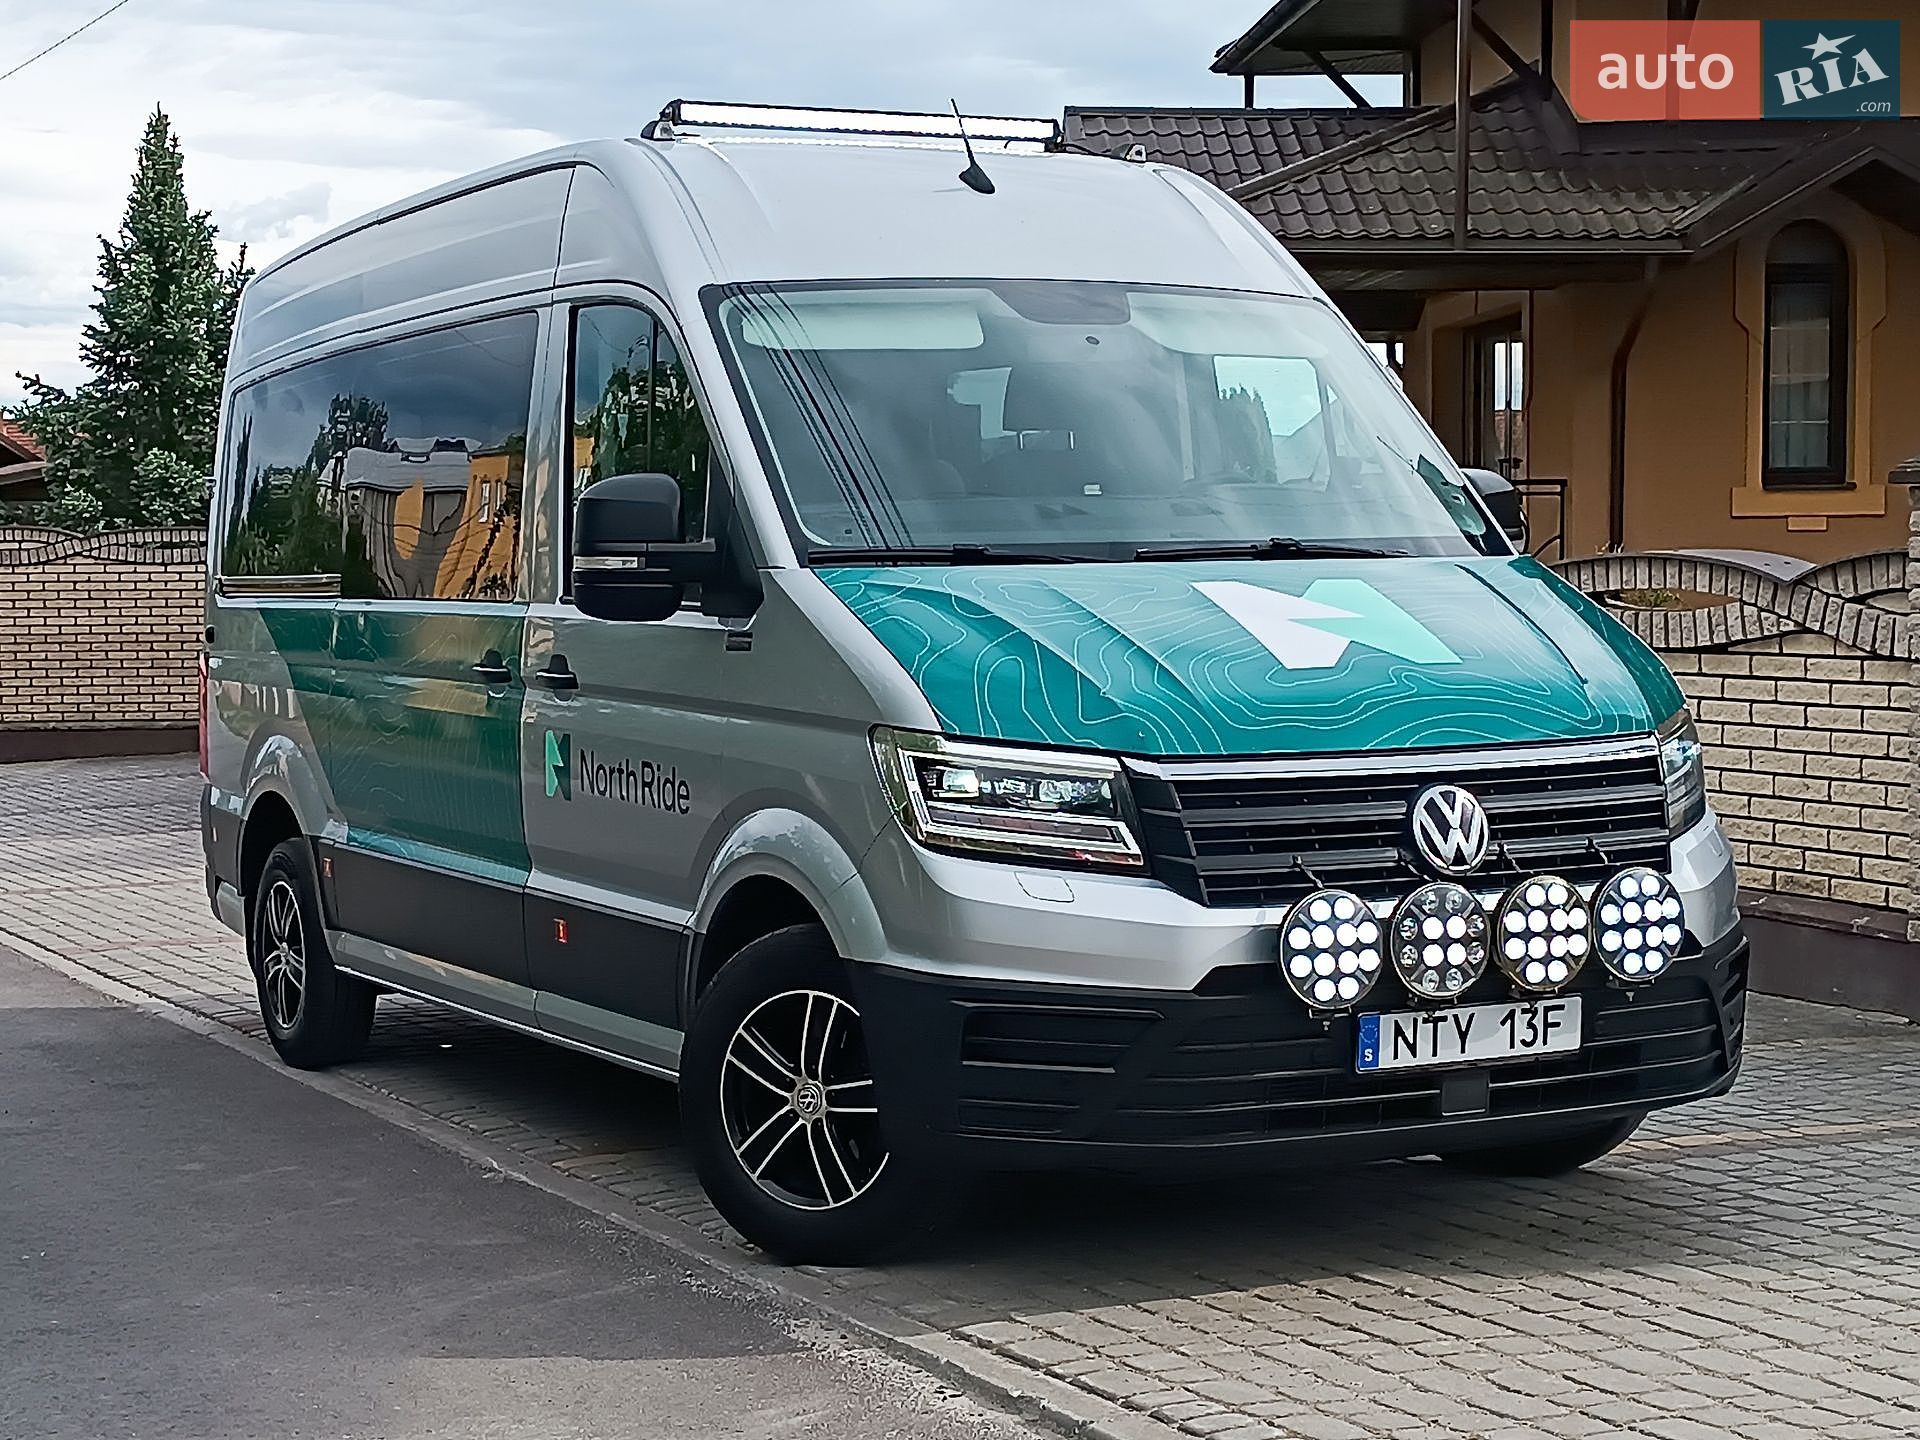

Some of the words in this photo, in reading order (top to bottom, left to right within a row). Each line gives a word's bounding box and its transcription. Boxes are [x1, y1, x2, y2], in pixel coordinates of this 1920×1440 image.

[1393, 1012, 1476, 1061] NTY
[1499, 1004, 1566, 1050] 13F
[1364, 1048, 1374, 1062] S
